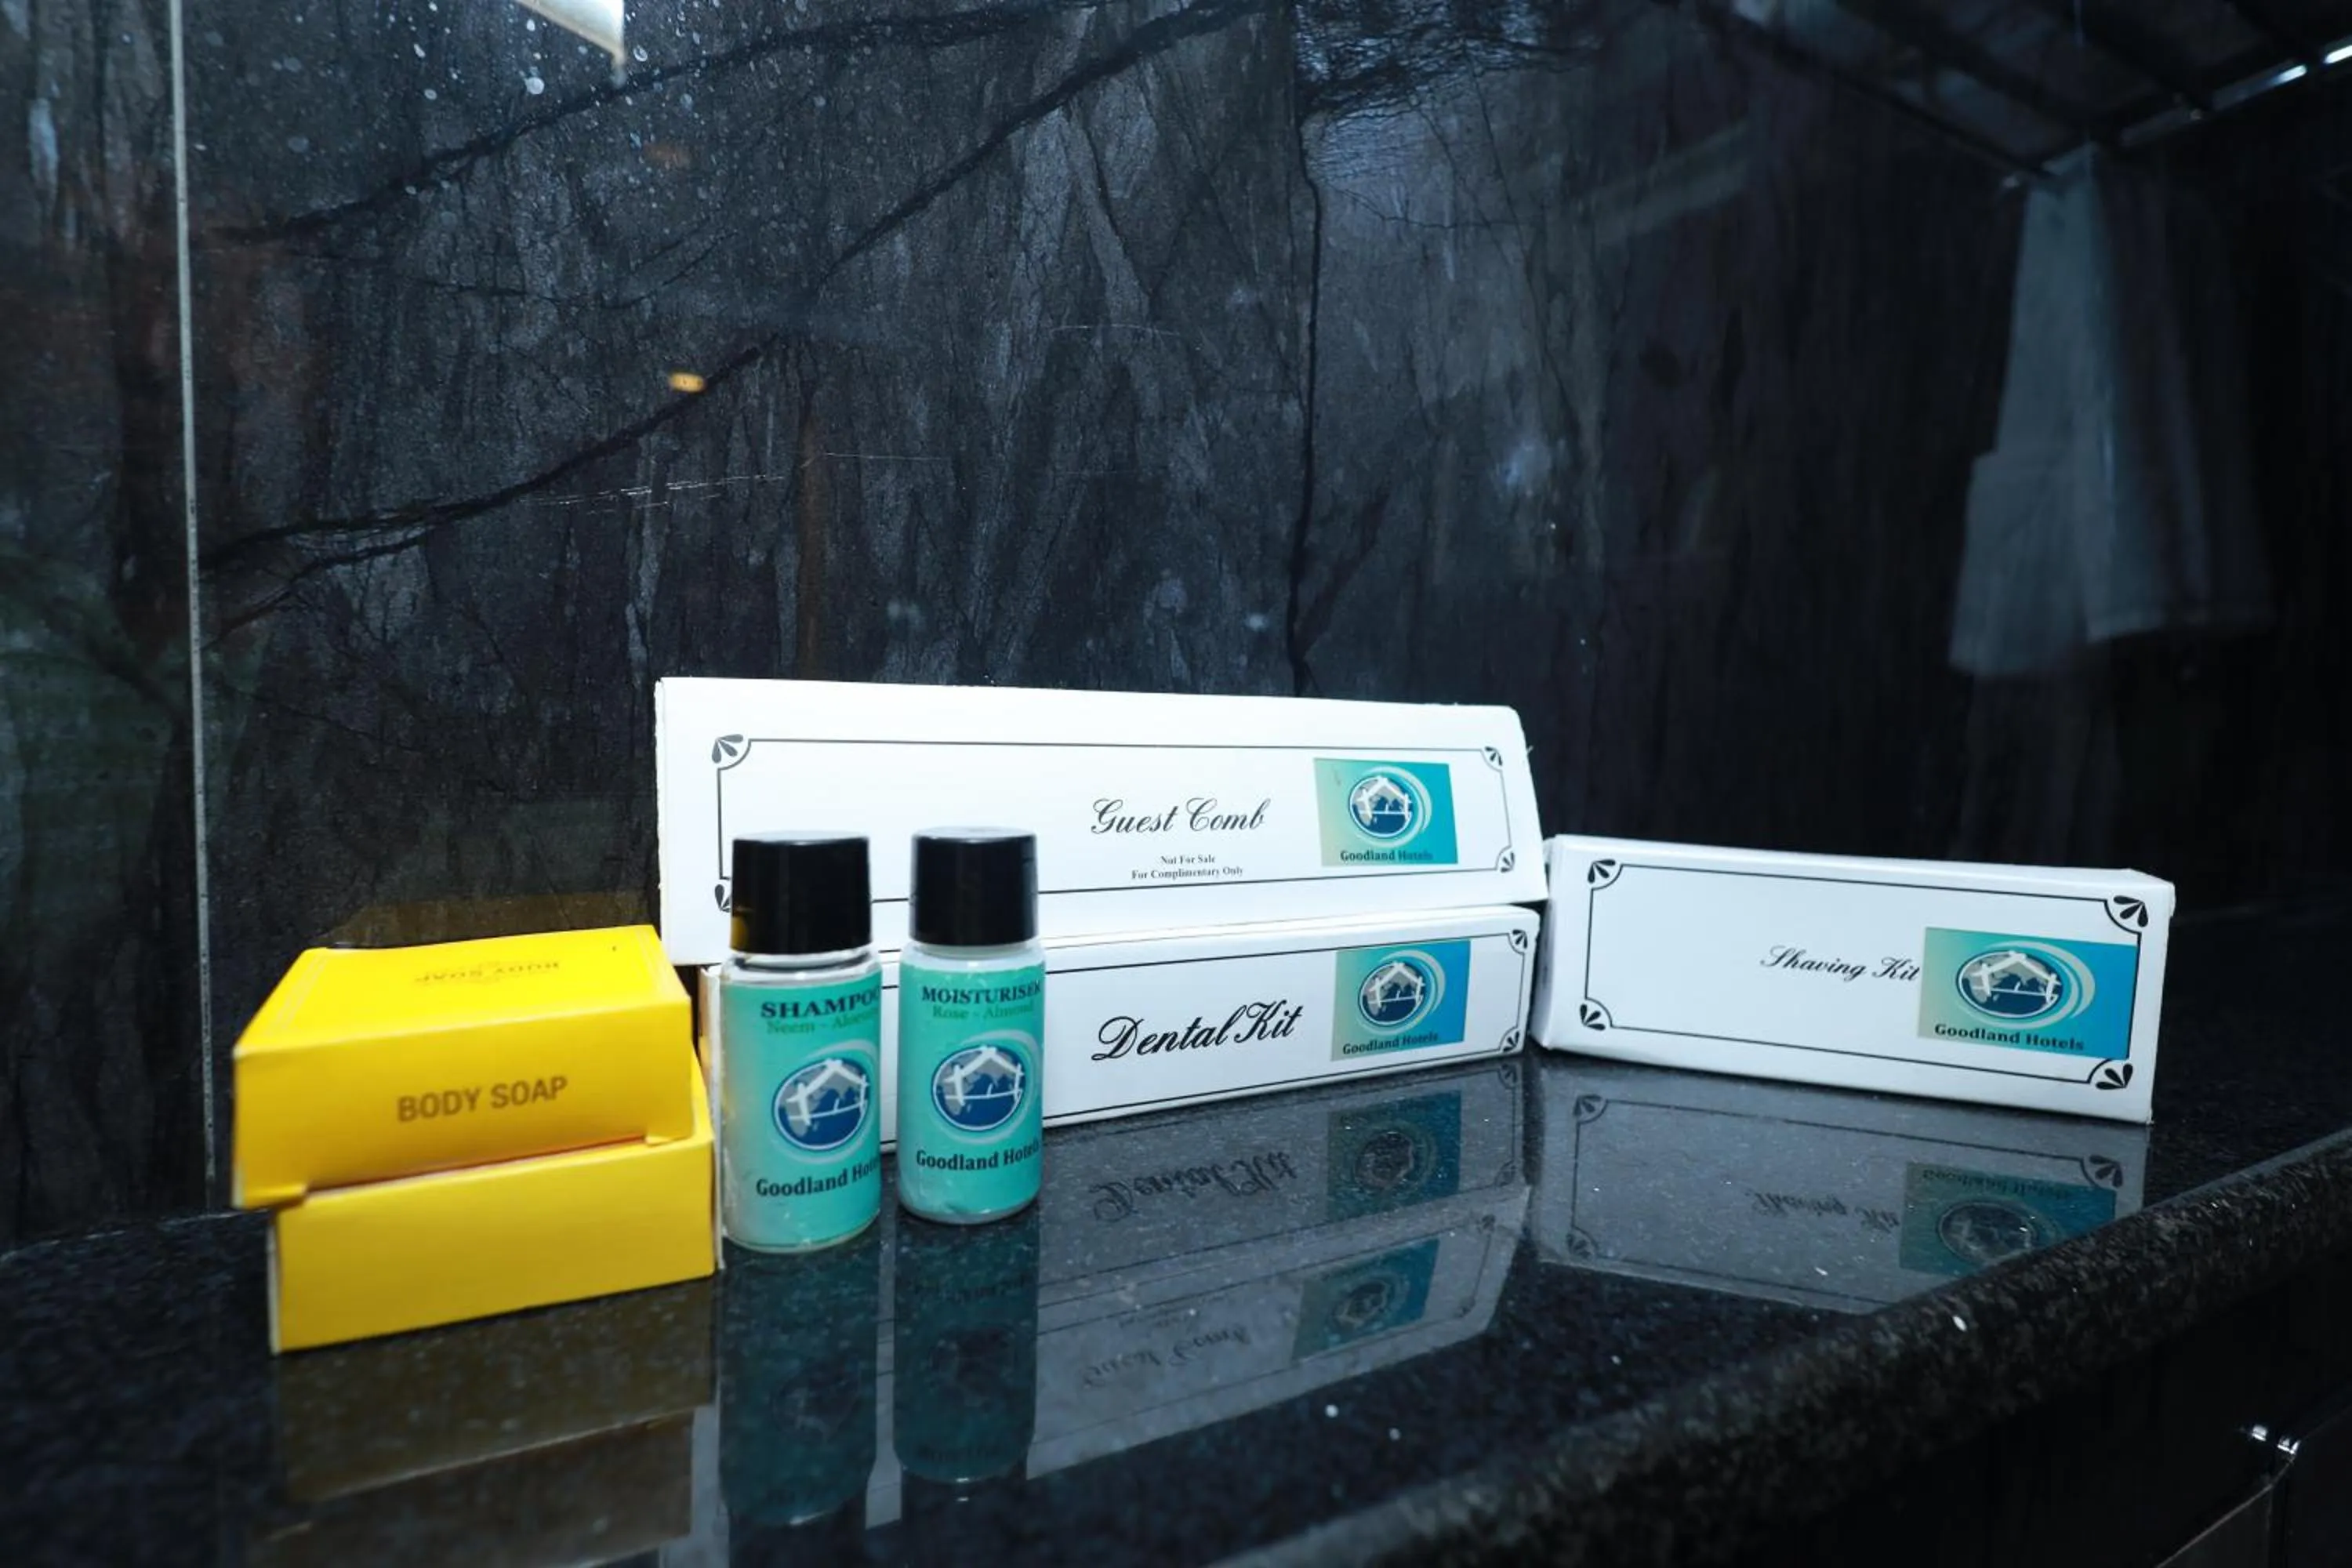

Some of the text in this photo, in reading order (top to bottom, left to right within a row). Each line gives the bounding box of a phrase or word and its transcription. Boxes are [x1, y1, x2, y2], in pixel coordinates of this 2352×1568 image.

[1091, 797, 1272, 834] Guest Comb
[1160, 855, 1216, 865] Not For Sale
[1340, 849, 1396, 861] Goodland
[1131, 866, 1243, 880] For Complimentary Only
[1760, 946, 1920, 982] Shaving Kit
[1091, 1000, 1304, 1061] Dental Kit
[1342, 1031, 1439, 1054] Goodland Hotels
[1935, 1024, 2085, 1051] Goodland Hotels
[397, 1076, 568, 1123] BODY SOAP
[916, 1149, 999, 1171] Goodland
[756, 1156, 880, 1196] Goodland Hote
